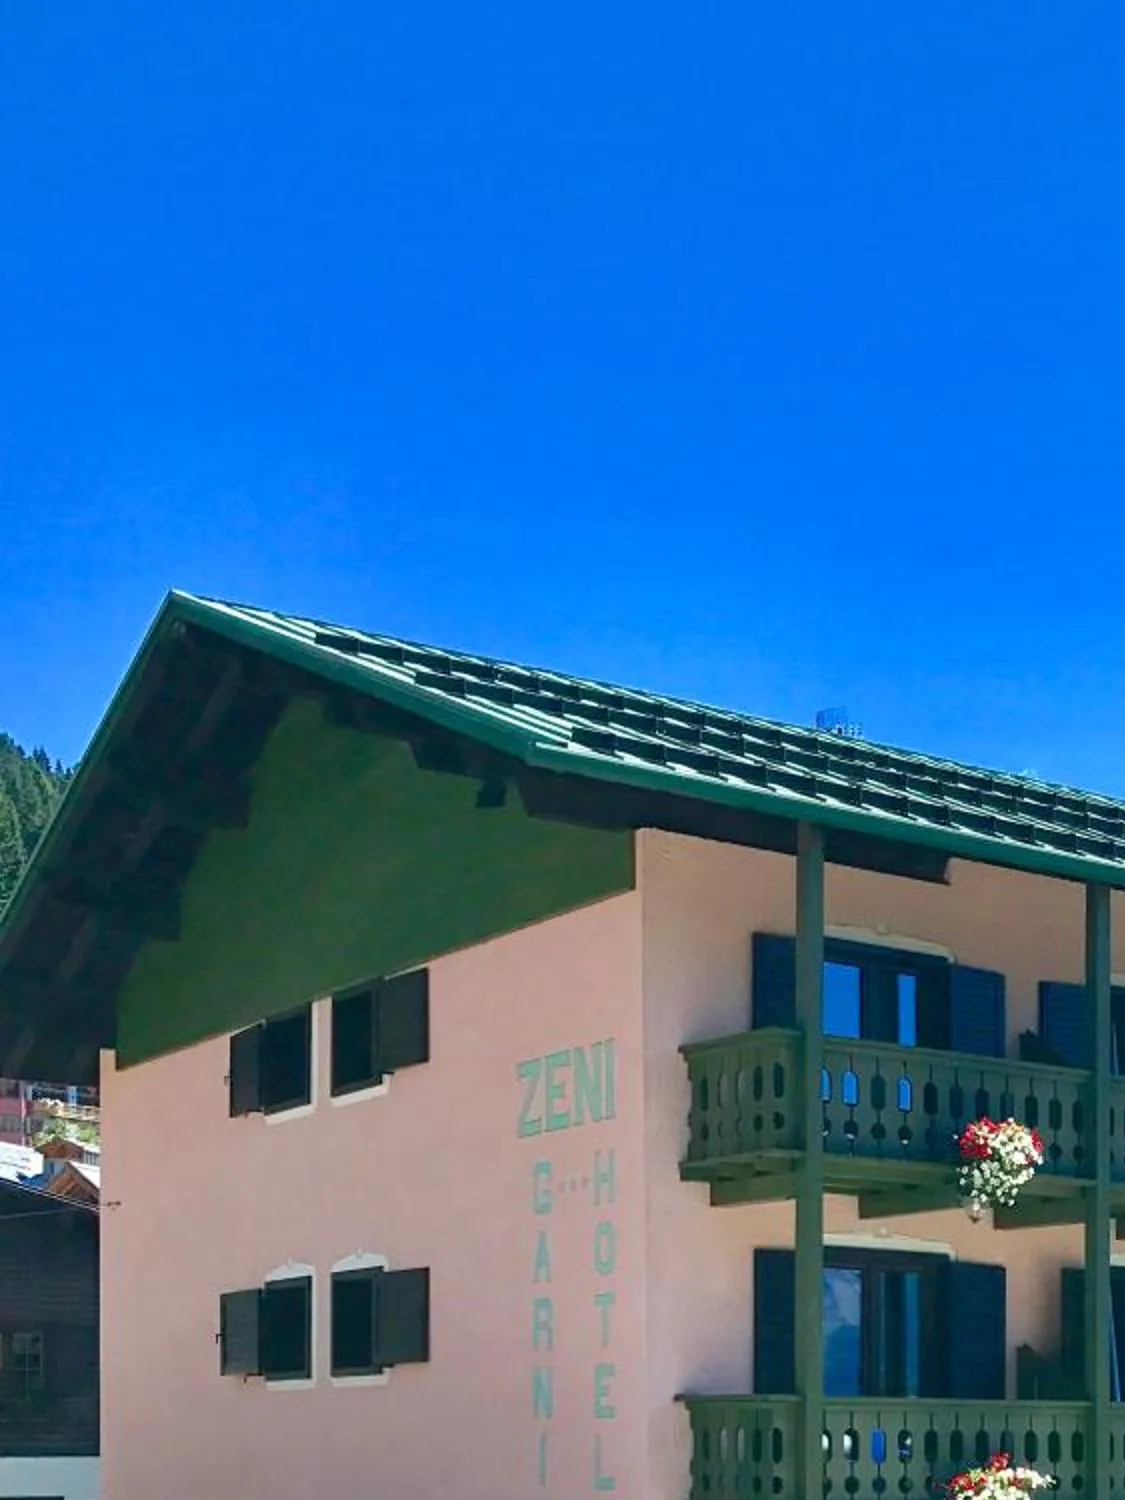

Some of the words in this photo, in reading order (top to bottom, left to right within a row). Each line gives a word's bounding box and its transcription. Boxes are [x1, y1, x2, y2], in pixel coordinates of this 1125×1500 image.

[516, 1037, 616, 1139] ZENI
[532, 1160, 555, 1488] GARNI
[593, 1148, 616, 1491] HOTEL
